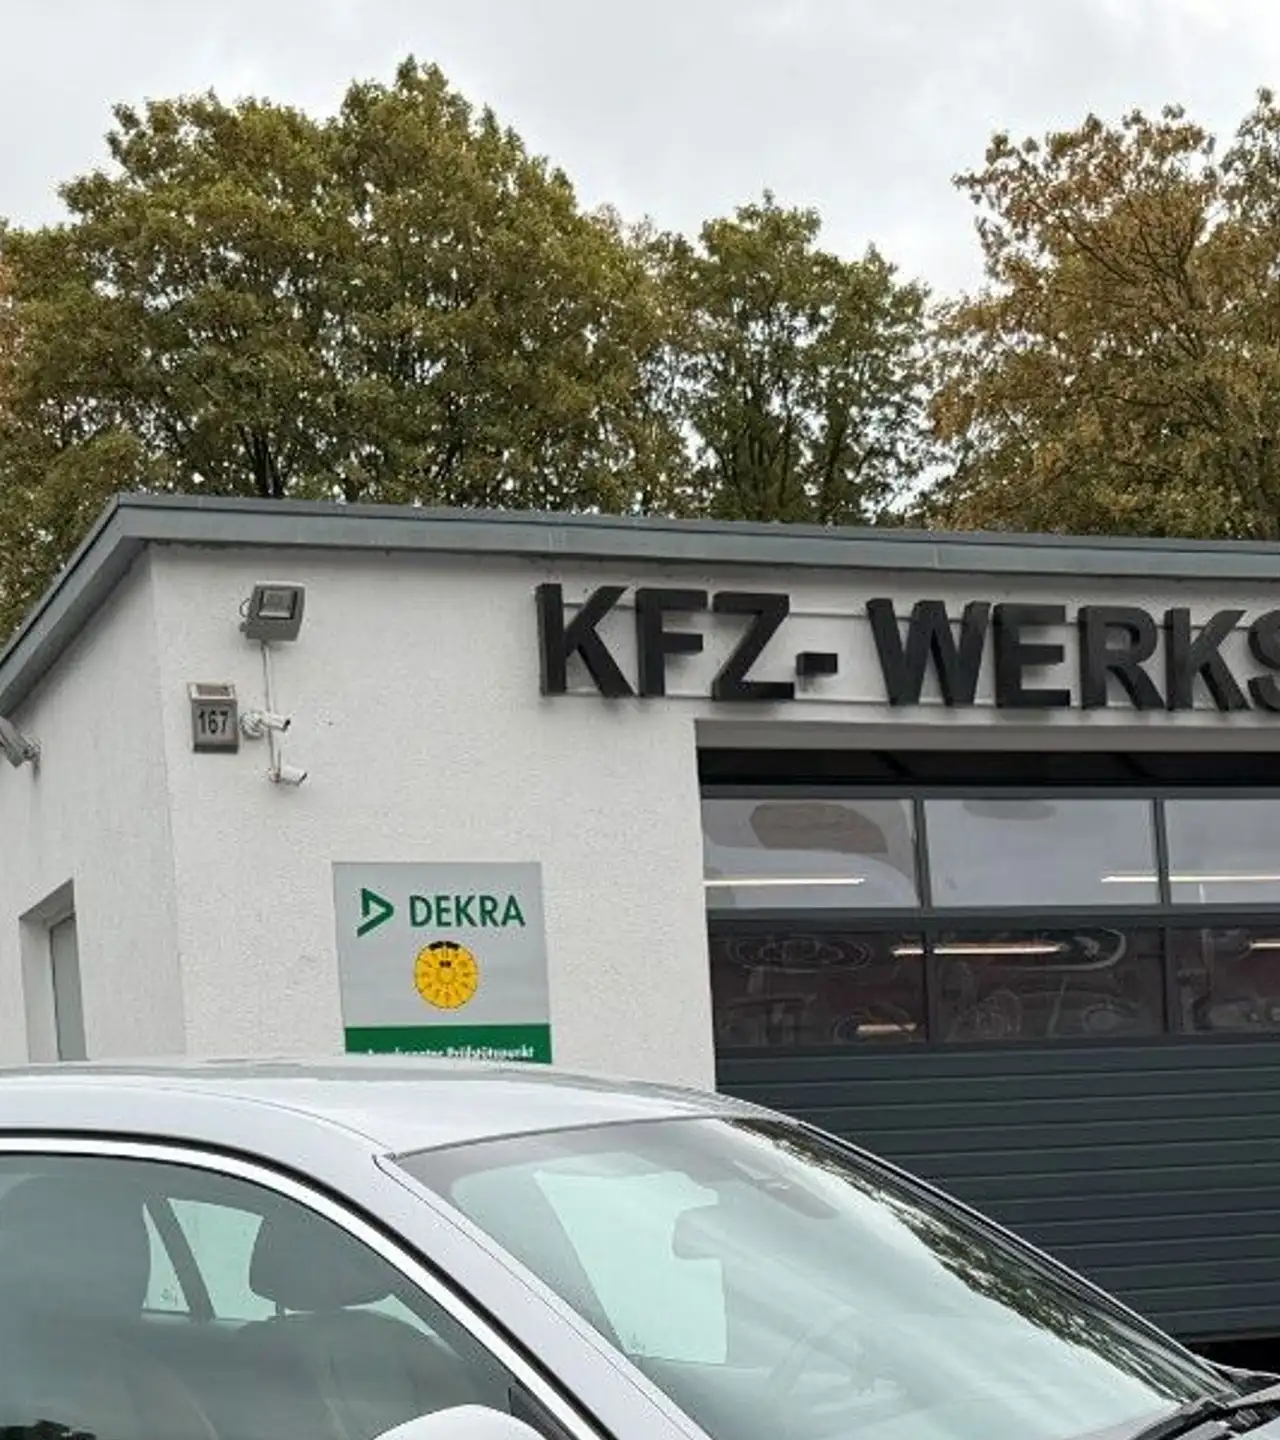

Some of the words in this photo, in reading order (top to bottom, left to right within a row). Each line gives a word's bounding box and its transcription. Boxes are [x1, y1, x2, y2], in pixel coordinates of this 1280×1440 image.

[534, 582, 839, 701] KFZ-
[197, 709, 230, 736] 167
[408, 894, 527, 928] DEKRA
